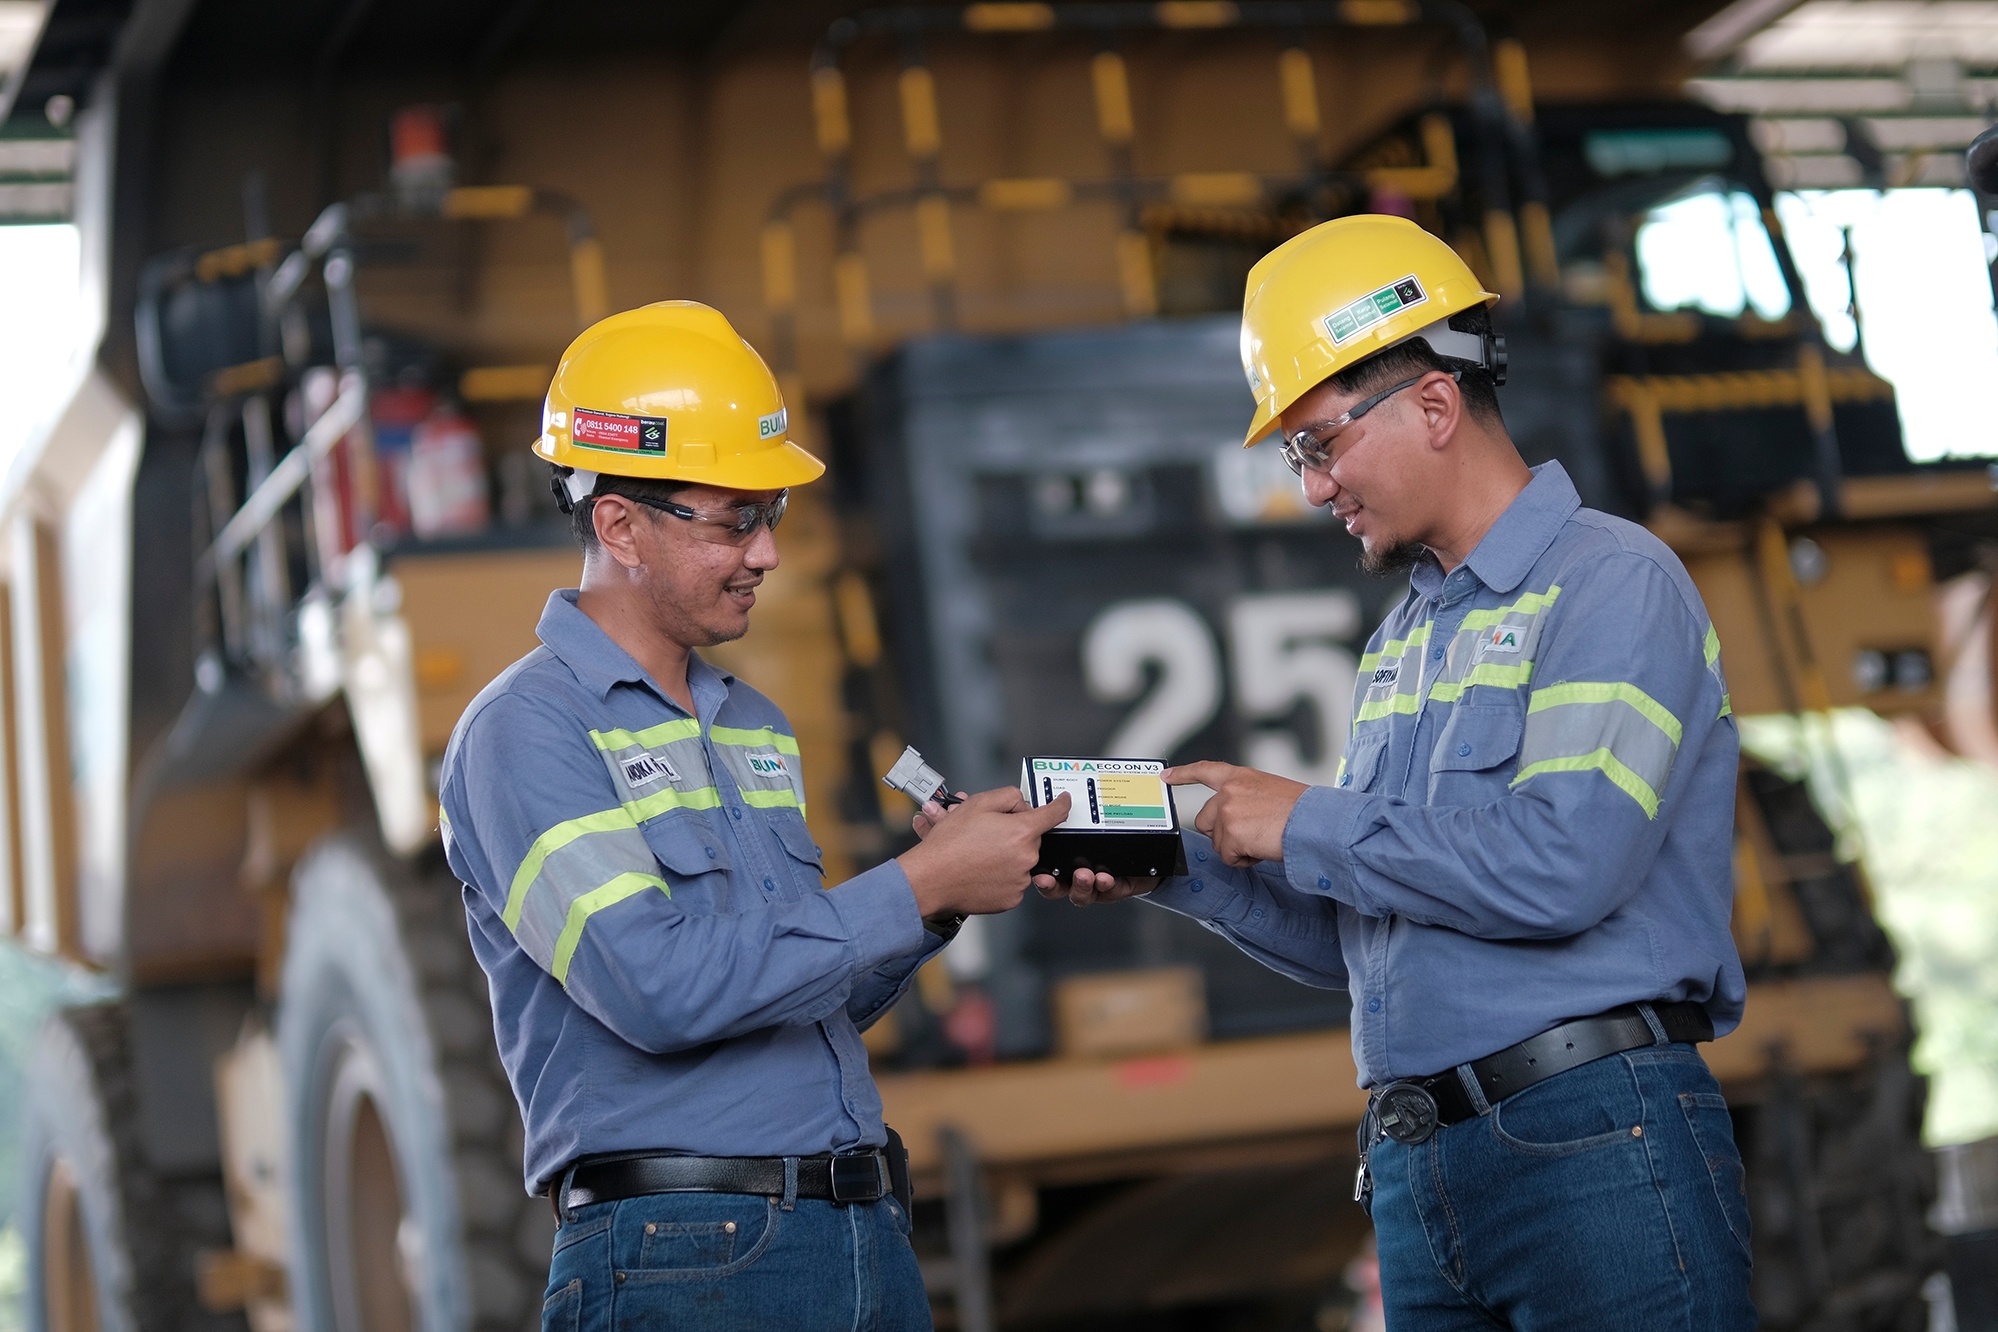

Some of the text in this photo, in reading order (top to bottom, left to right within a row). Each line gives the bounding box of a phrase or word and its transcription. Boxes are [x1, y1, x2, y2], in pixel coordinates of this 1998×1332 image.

[1356, 305, 1371, 314] Kerja
[1331, 315, 1351, 328] Datang
[586, 420, 638, 434] 0811 5400 148
[1034, 761, 1096, 771] BUMA
